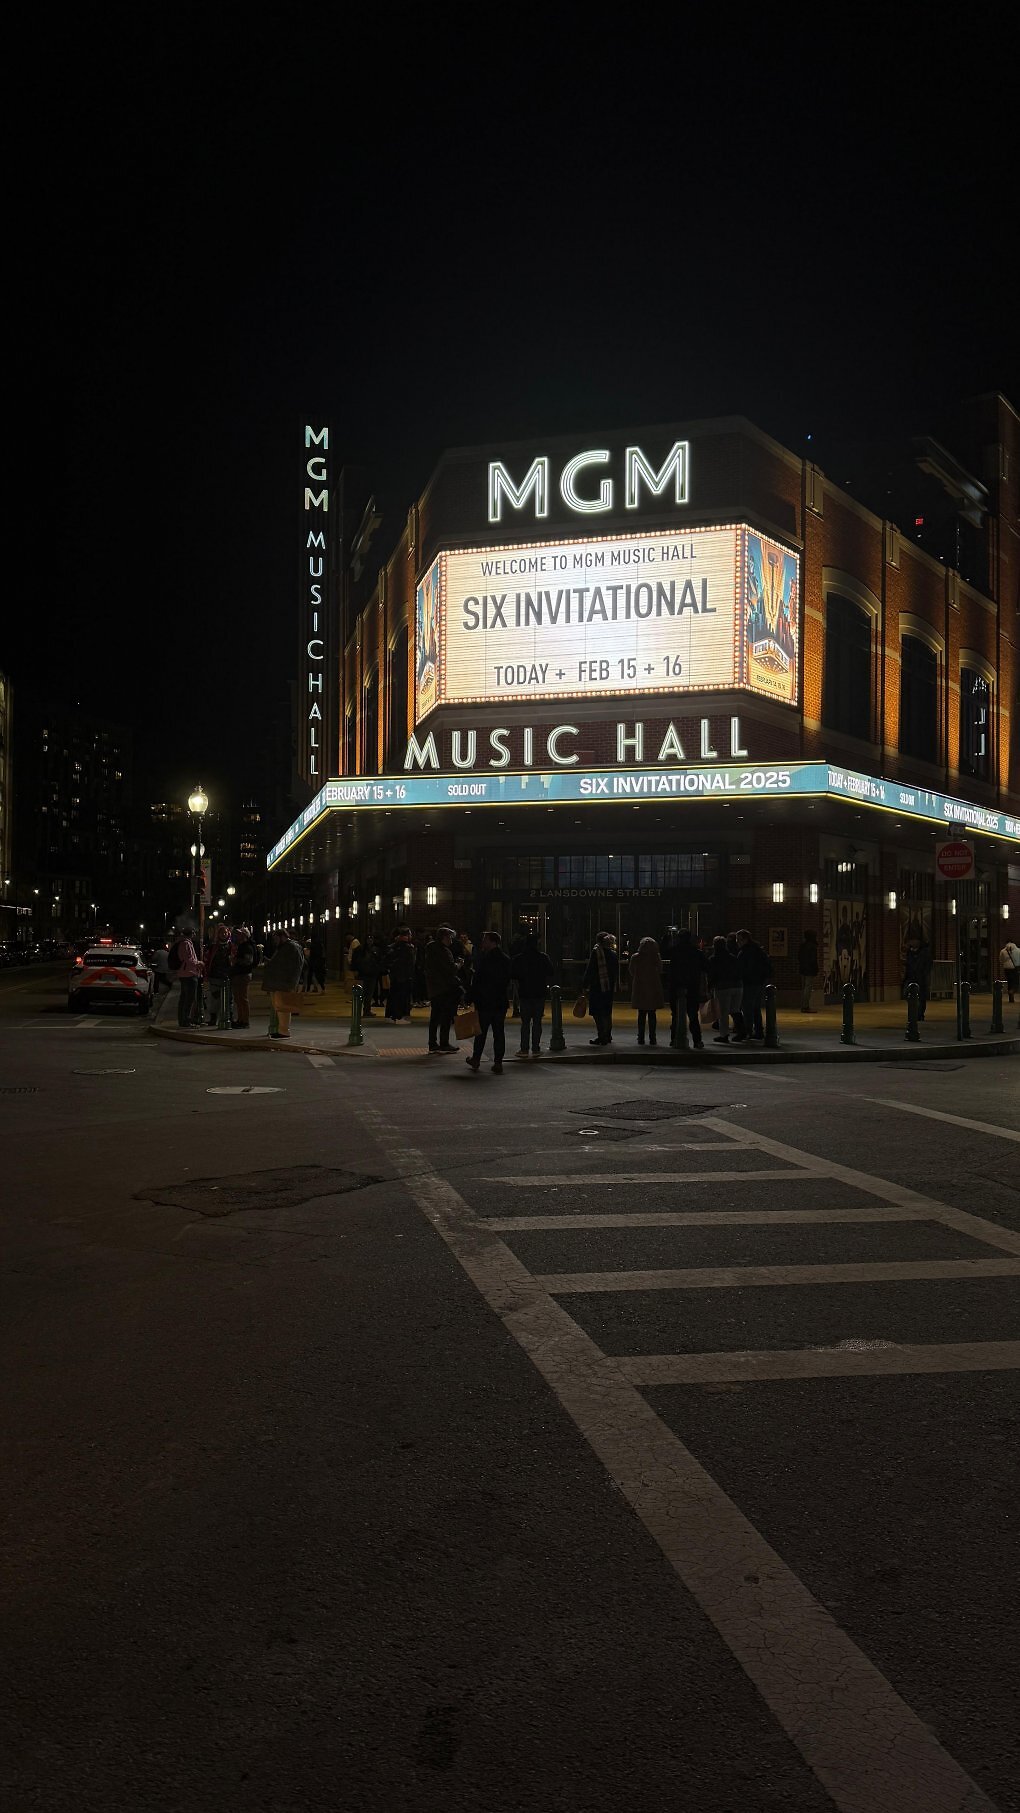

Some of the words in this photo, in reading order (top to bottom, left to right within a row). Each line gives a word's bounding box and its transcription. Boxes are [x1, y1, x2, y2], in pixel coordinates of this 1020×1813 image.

[304, 426, 328, 512] MGM
[488, 440, 690, 522] MGM
[481, 556, 546, 576] WELCOME
[552, 554, 567, 570] TO
[573, 551, 605, 568] MGM
[611, 548, 656, 566] MUSIC
[662, 544, 697, 562] HALL
[306, 530, 326, 660] MUSIC
[462, 594, 508, 630] SIX
[515, 578, 717, 627] INVITATIONAL
[494, 663, 550, 686] TODAY
[555, 669, 566, 679] +
[578, 659, 610, 682] FEB
[618, 658, 637, 680] 15
[644, 663, 655, 675] +
[663, 654, 682, 677] 16
[308, 672, 323, 775] HALL
[404, 725, 580, 769] MUSIC
[617, 716, 748, 762] HALL
[373, 786, 384, 799] 15
[386, 788, 394, 797] +
[396, 784, 406, 798] 16
[448, 784, 469, 796] SOLD
[470, 783, 487, 795] OUT
[580, 778, 609, 794] SIX
[613, 773, 736, 794] INVITATIONAL
[740, 771, 791, 788] 2025
[986, 814, 998, 829] 2025
[954, 849, 968, 857] NOT
[540, 889, 614, 897] LANSDOWNE
[617, 888, 663, 897] STREET
